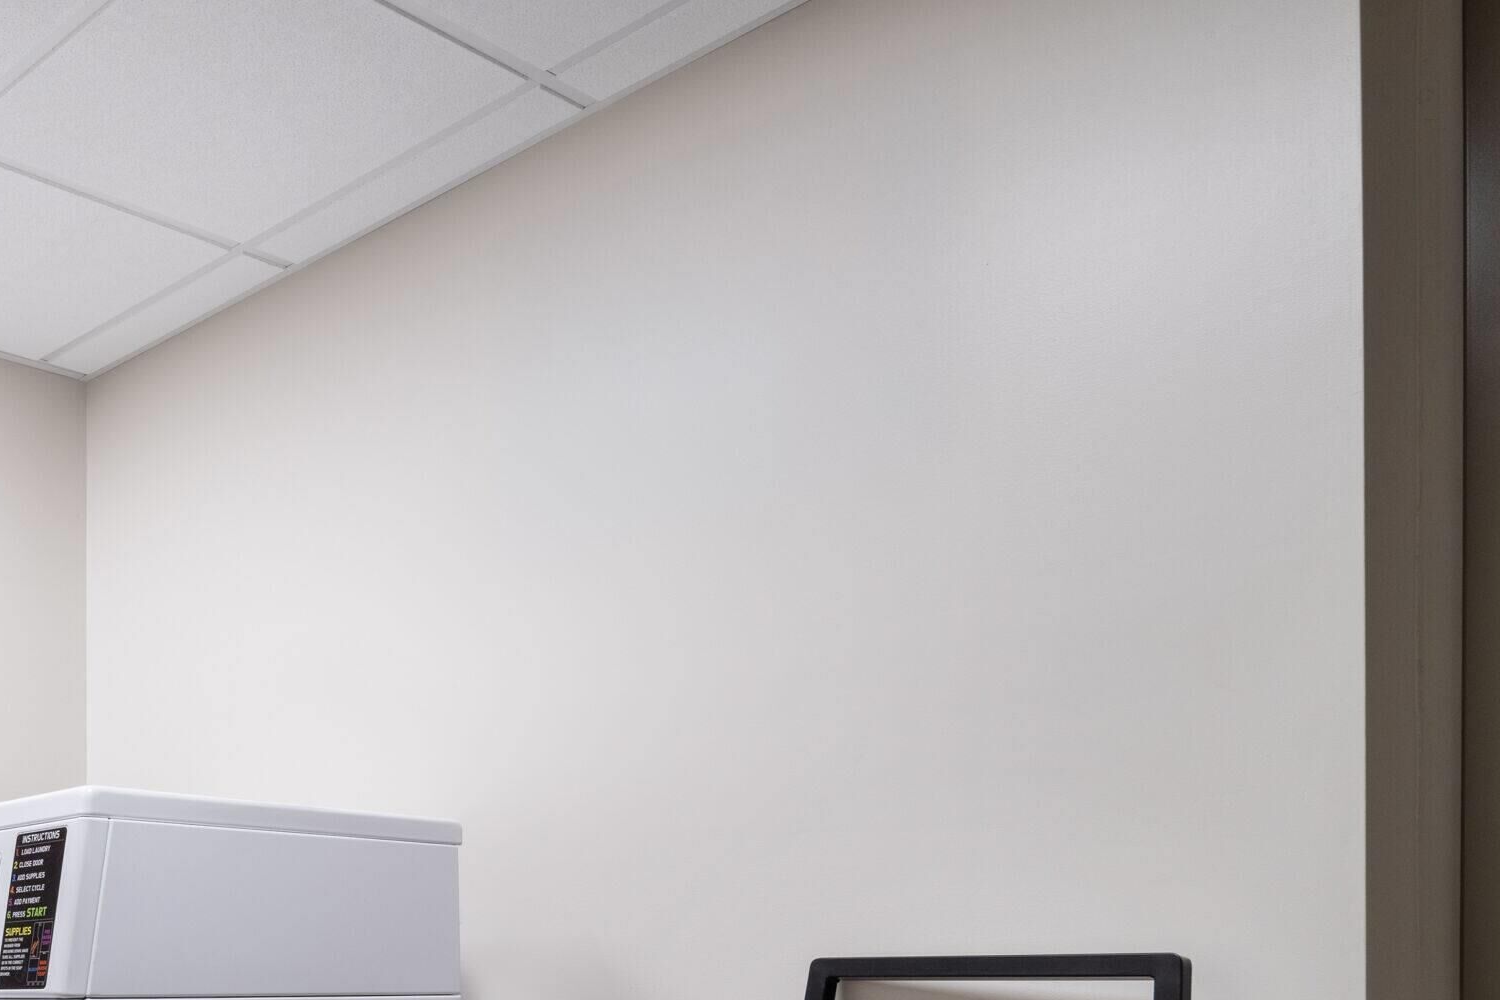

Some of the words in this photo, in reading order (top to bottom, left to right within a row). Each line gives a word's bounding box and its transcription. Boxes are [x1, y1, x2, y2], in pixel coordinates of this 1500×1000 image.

[22, 830, 60, 844] INSTRUCTIONS
[32, 845, 51, 853] LAUNDRY
[26, 872, 45, 880] SUPPLIES
[16, 885, 31, 894] SELECT
[26, 906, 47, 917] START
[5, 926, 32, 936] SUPPLIES
